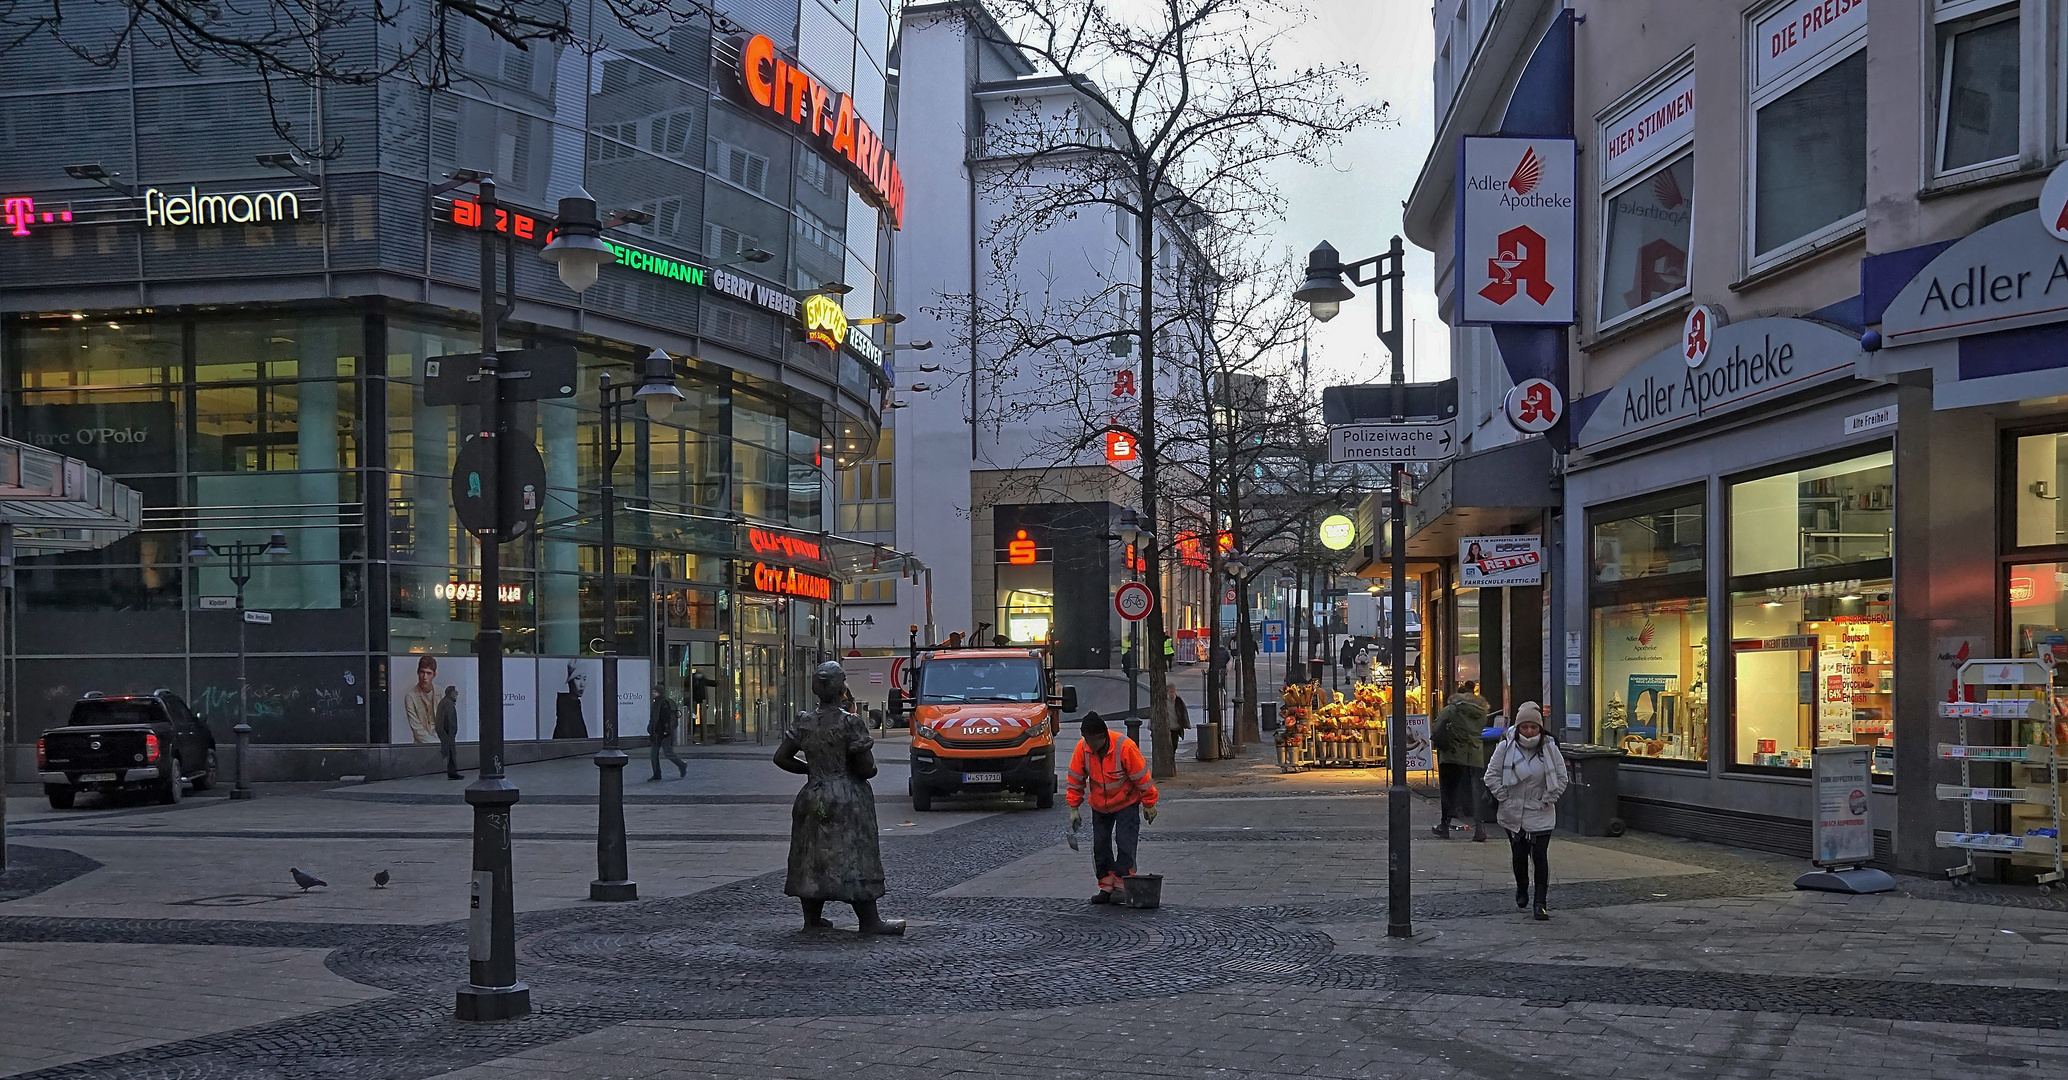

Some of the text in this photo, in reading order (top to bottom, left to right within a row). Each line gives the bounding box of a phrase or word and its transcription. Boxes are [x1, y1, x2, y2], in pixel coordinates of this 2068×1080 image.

[1771, 21, 1798, 59] DIE
[1608, 88, 1693, 162] HIER STIMMEN
[1467, 175, 1508, 191] Adler
[145, 186, 299, 227] fielmann
[1499, 192, 1572, 212] Apotheke
[713, 268, 797, 318] GERRY WEBER
[1919, 264, 2032, 316] Adler
[807, 300, 848, 340] SMYTHS
[850, 331, 882, 366] RESERVED
[1622, 334, 1794, 427] Adler Apotheke
[1852, 410, 1889, 430] Alte Freiheit
[1343, 429, 1434, 443] Polizeiwache
[1343, 445, 1417, 458] Innenstadt
[1484, 553, 1536, 570] RETTIG
[754, 561, 830, 601] CITY-ARKADEN
[1464, 578, 1539, 586] FAHRSCHULE-RETTIG.DE
[1834, 616, 1847, 626] WIR
[1763, 637, 1806, 650] ANGEBOT DES MONATS
[1842, 633, 1870, 643] Deutsch
[1828, 689, 1842, 700] 64%
[1842, 694, 1867, 705] English
[963, 726, 1000, 735] IVECO
